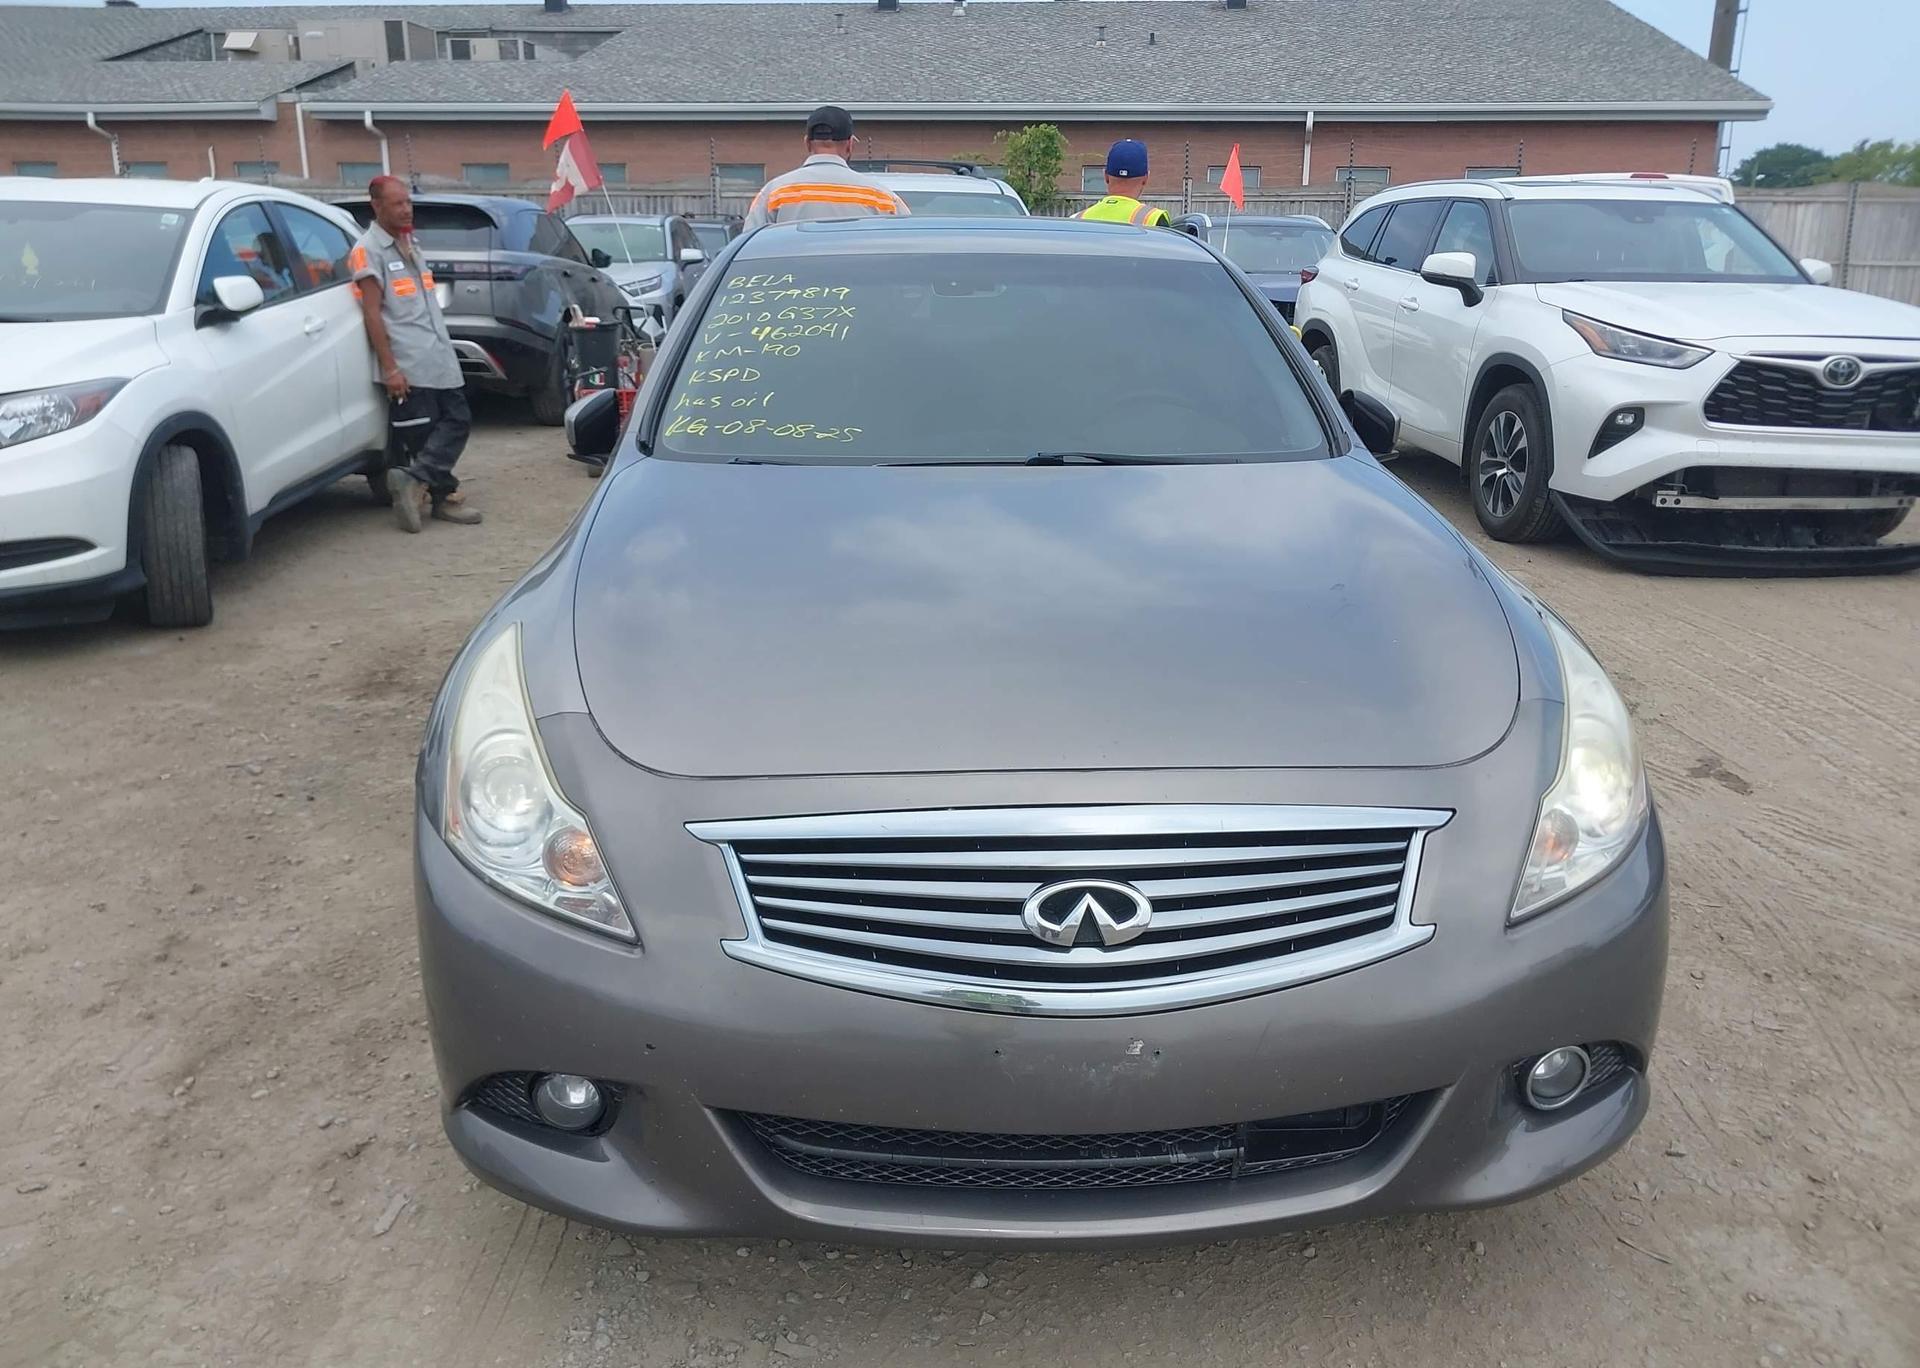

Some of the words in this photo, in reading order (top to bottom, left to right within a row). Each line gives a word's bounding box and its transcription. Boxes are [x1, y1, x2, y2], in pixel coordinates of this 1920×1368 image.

[727, 273, 797, 289] BELA
[707, 312, 771, 329] 2010
[777, 306, 856, 321] G37X
[688, 368, 761, 385] KSPD
[731, 392, 775, 408] oil
